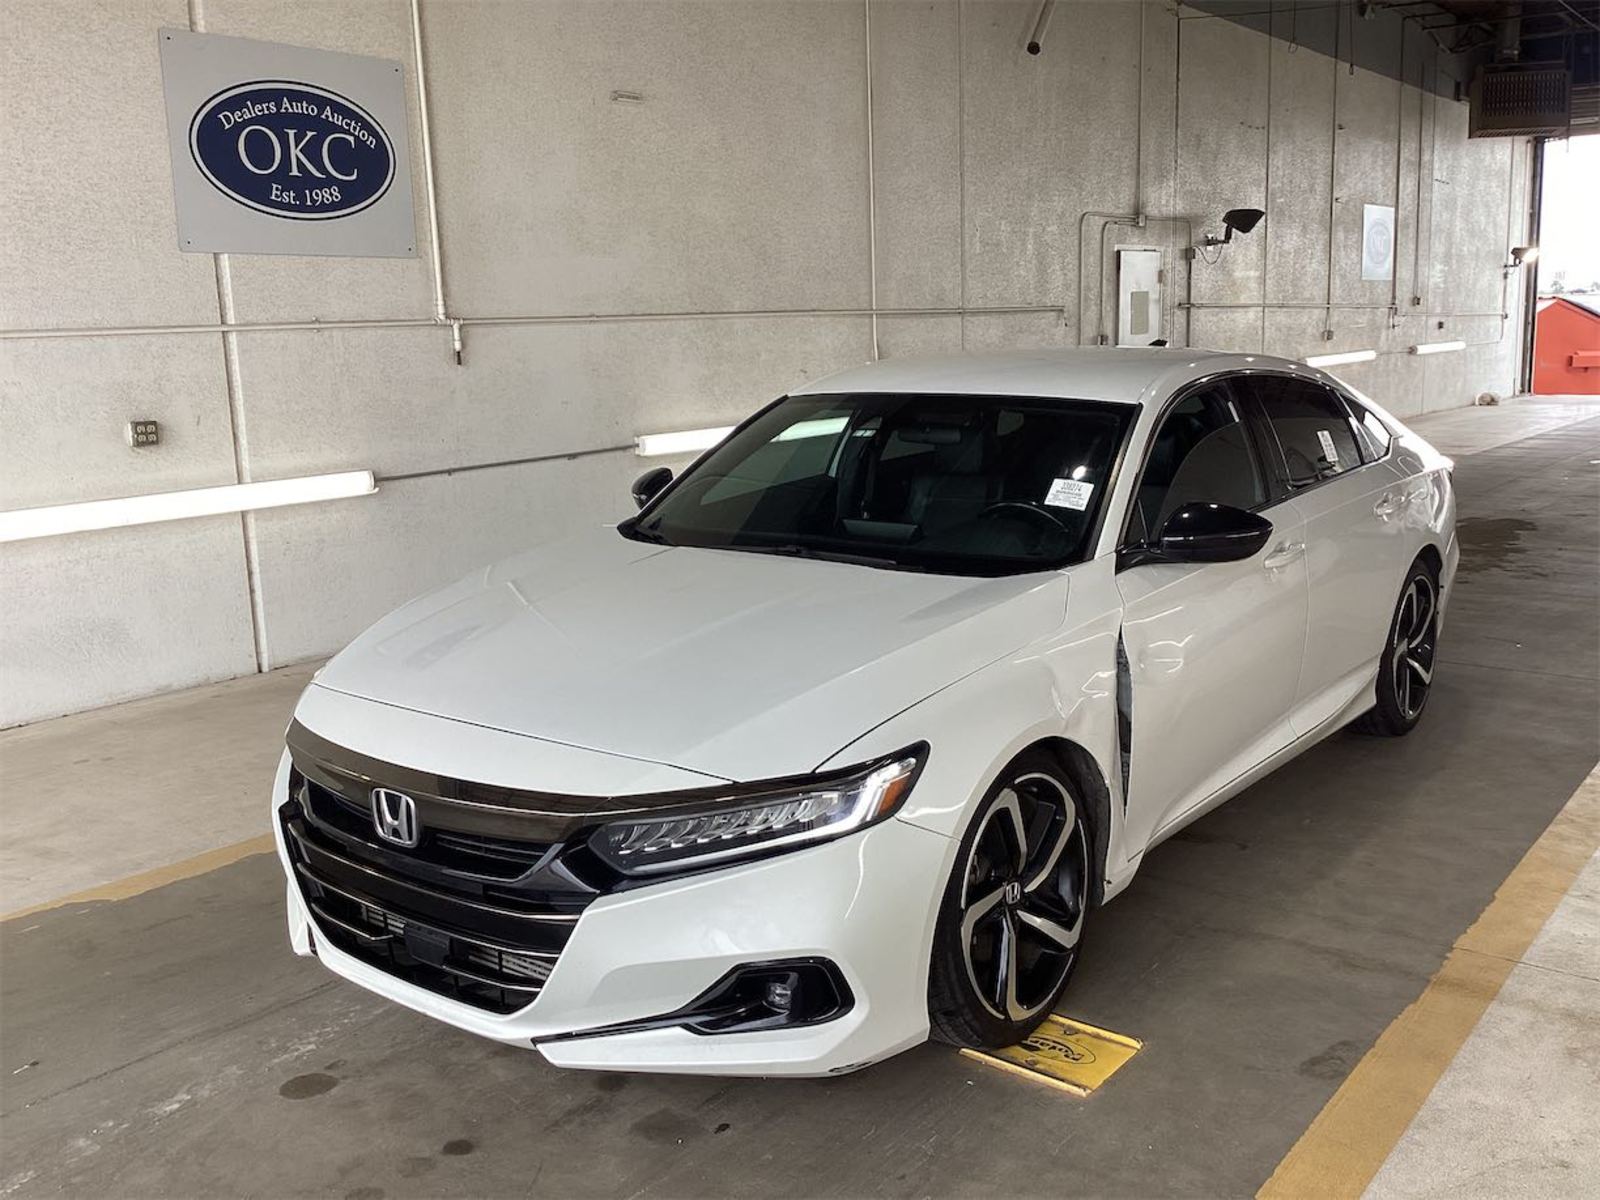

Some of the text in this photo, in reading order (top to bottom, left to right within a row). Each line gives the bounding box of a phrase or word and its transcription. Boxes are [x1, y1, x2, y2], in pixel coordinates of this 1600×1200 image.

[217, 97, 377, 149] Dealers Auto Auction
[238, 125, 358, 181] OKC
[270, 183, 342, 206] Est. 1988
[1028, 1035, 1085, 1061] Rotar
